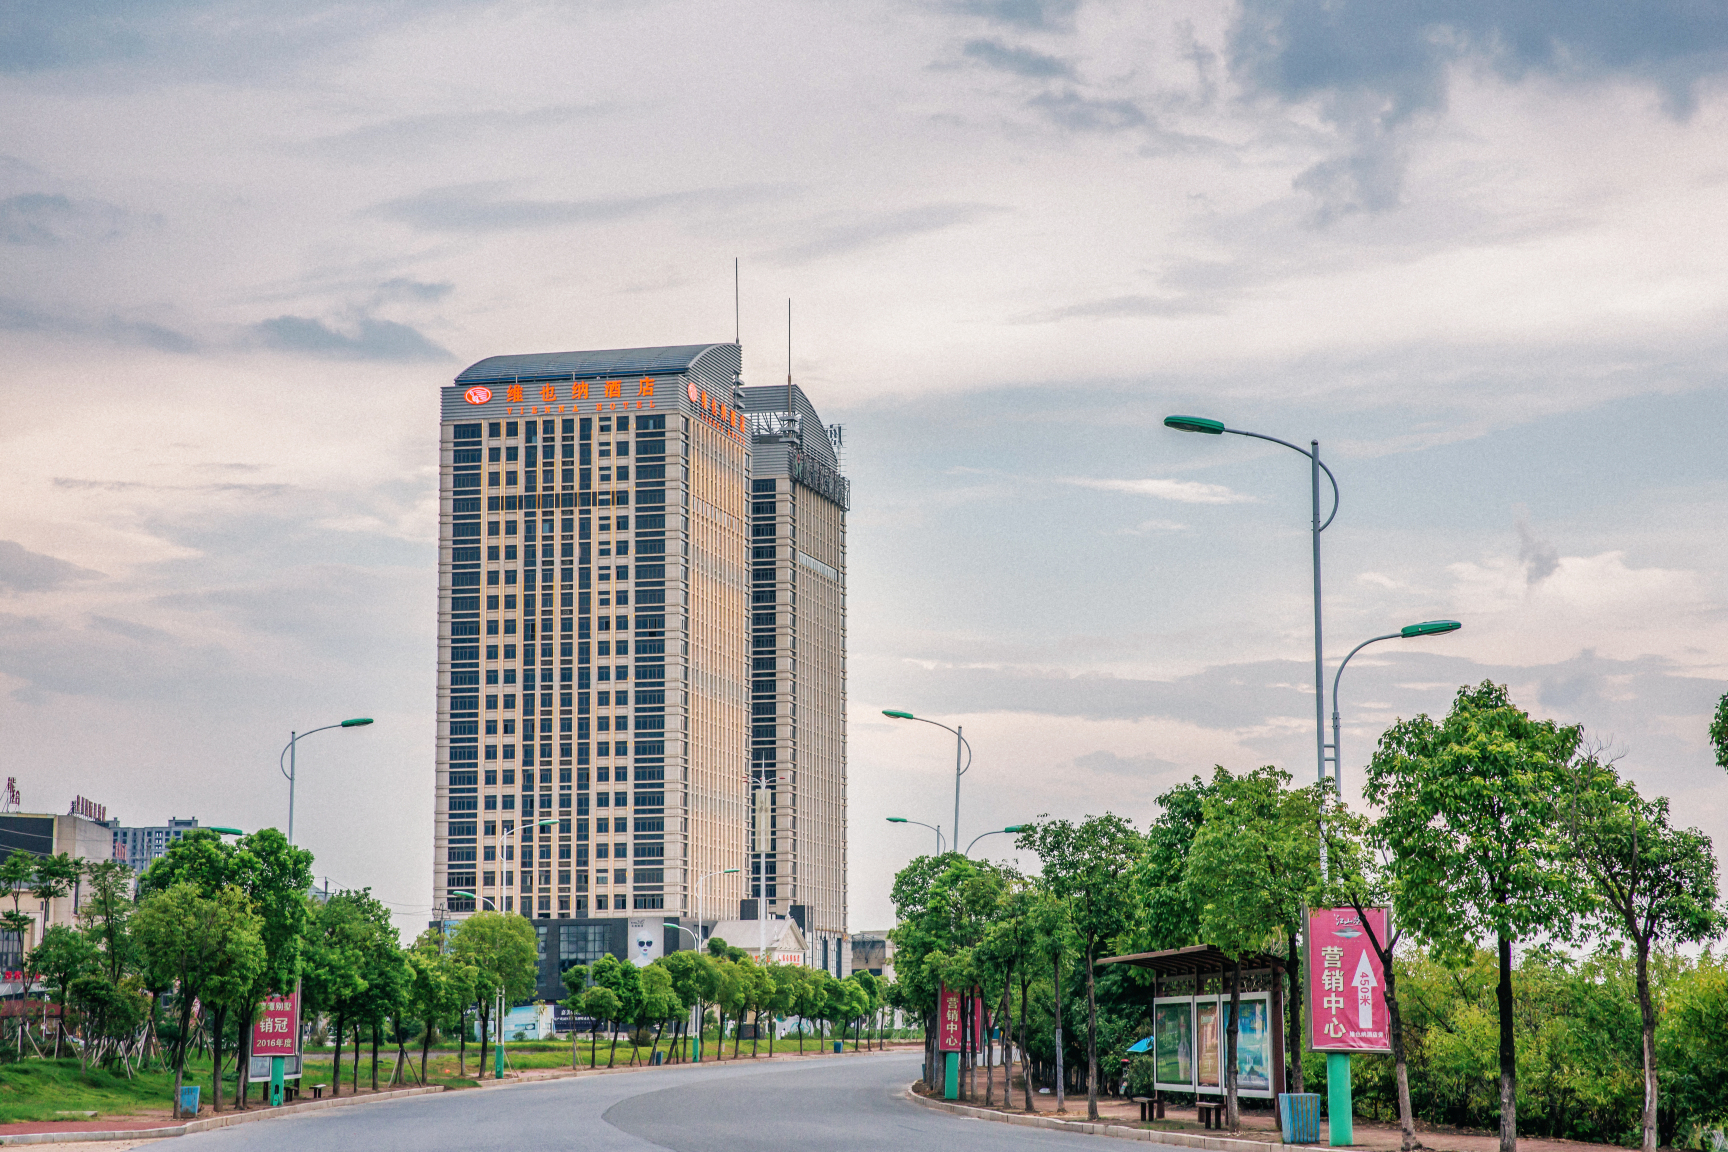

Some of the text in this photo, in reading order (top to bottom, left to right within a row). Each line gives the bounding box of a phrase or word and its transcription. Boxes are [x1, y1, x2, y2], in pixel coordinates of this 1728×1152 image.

[506, 376, 655, 403] 维也纳酒店
[506, 400, 656, 415] VIENNA HOTEL
[1321, 945, 1347, 1039] 营销中心
[1359, 971, 1371, 1007] 450米
[260, 1018, 288, 1033] 销冠
[946, 997, 958, 1046] 营销中心
[257, 1038, 292, 1048] 2016年度
